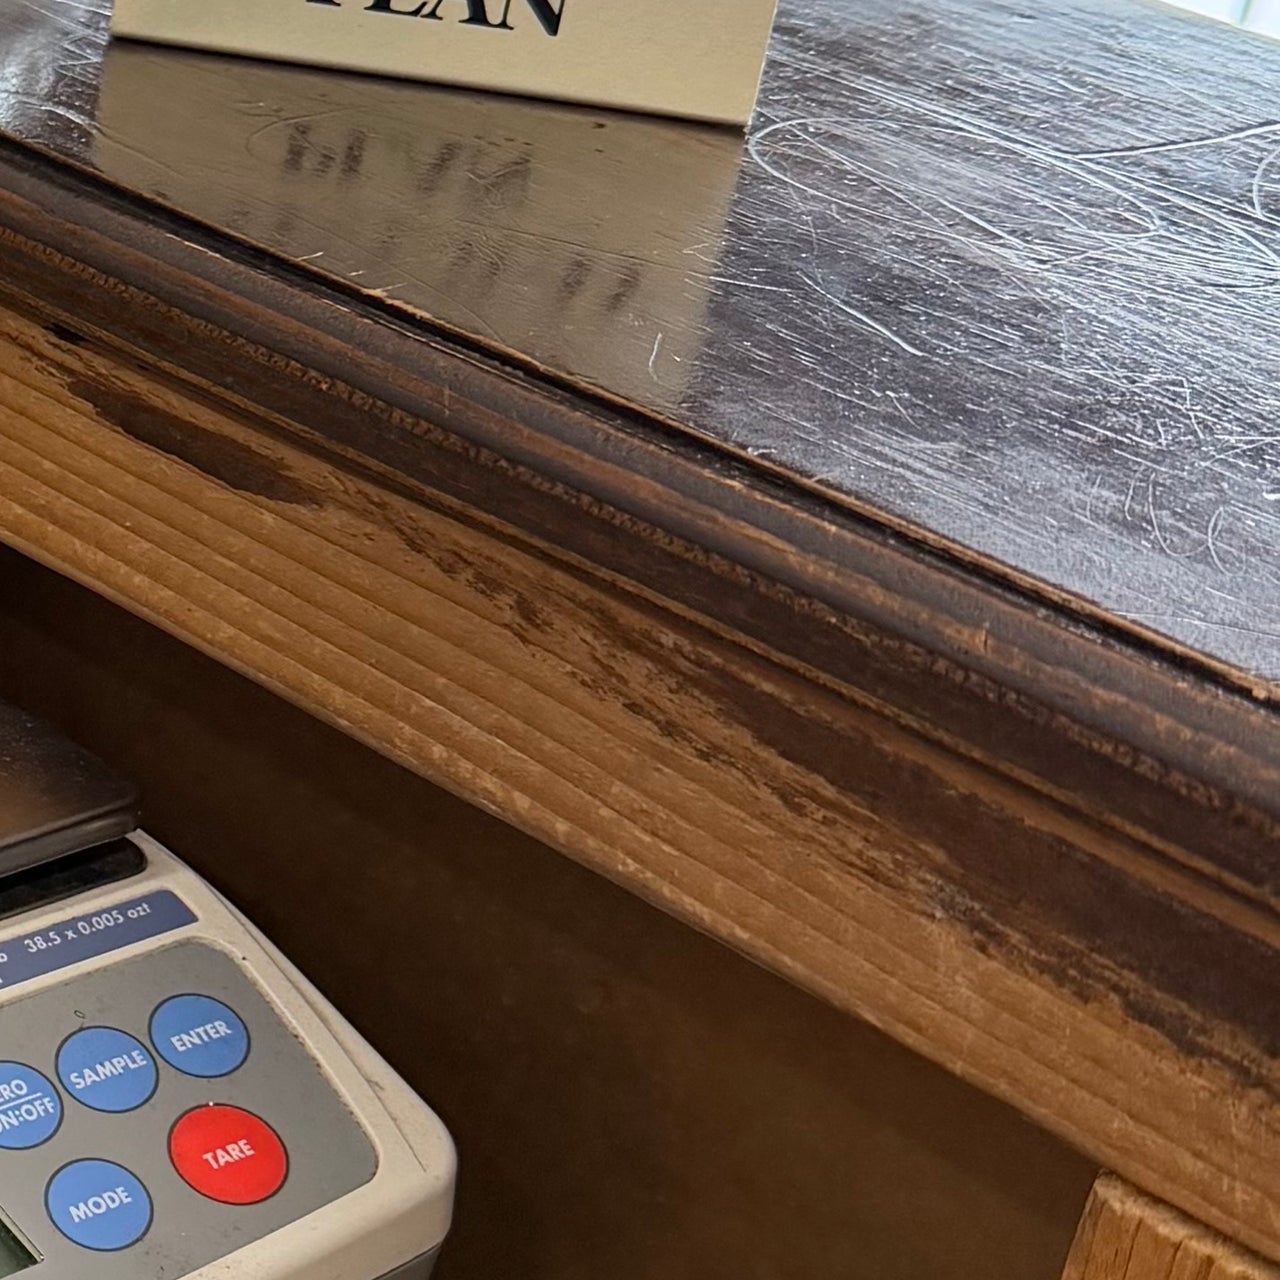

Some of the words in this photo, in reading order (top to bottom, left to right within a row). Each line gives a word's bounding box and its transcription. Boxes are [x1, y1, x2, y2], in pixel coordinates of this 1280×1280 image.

[24, 930, 62, 953] 38.5
[64, 928, 77, 940] x
[77, 909, 124, 935] 0.005
[170, 1019, 233, 1053] ENTER
[69, 1049, 148, 1090] SAMPLE
[202, 1139, 257, 1170] TARE
[68, 1186, 133, 1223] MODE
